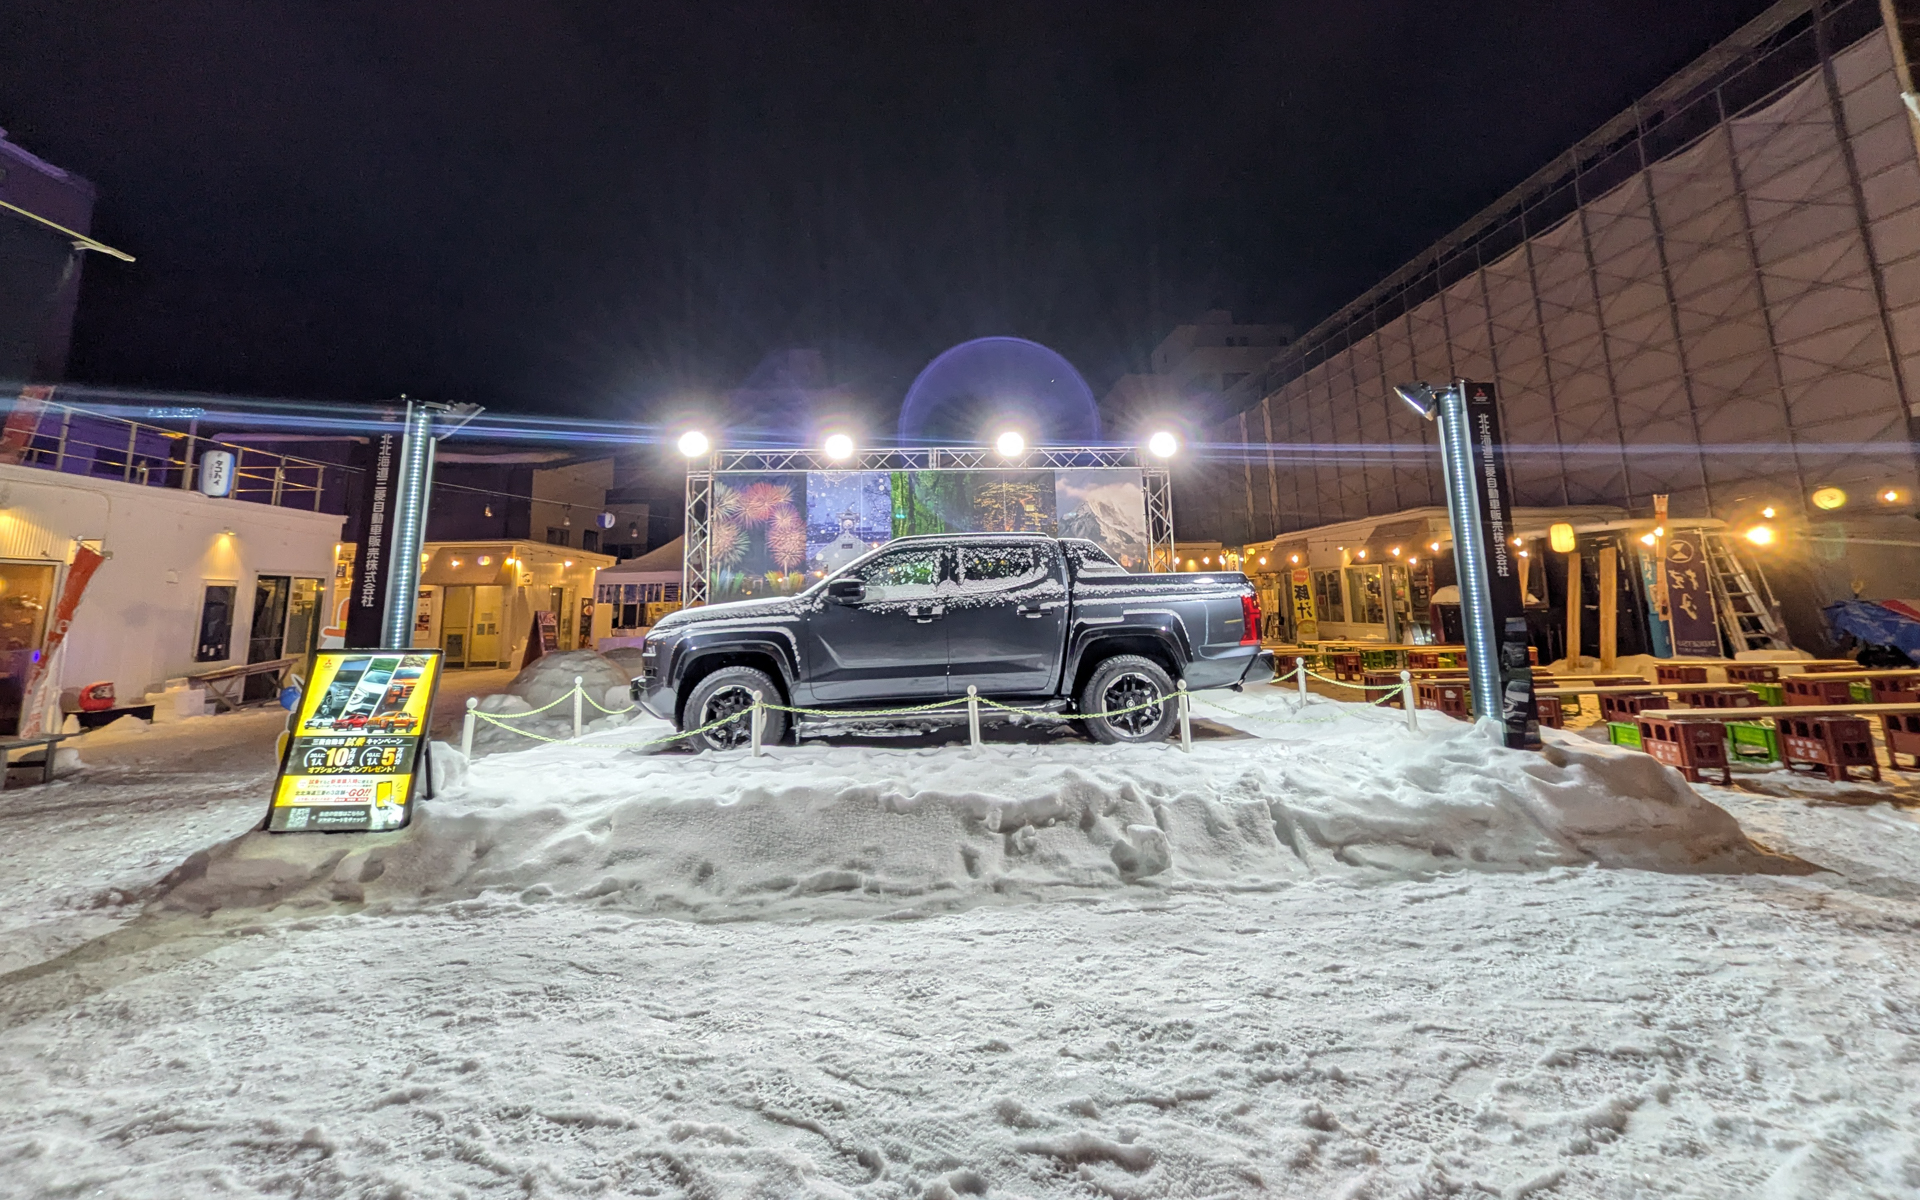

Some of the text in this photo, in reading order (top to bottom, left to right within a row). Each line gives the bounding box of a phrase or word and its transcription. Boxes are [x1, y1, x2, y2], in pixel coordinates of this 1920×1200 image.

[213, 460, 223, 486] タコハイ
[1477, 413, 1510, 577] 北北海道三菱自動車販売株式会社
[361, 433, 393, 607] 北北海道三菱自動車販売株式会社
[326, 747, 350, 767] 10
[381, 747, 397, 767] 5
